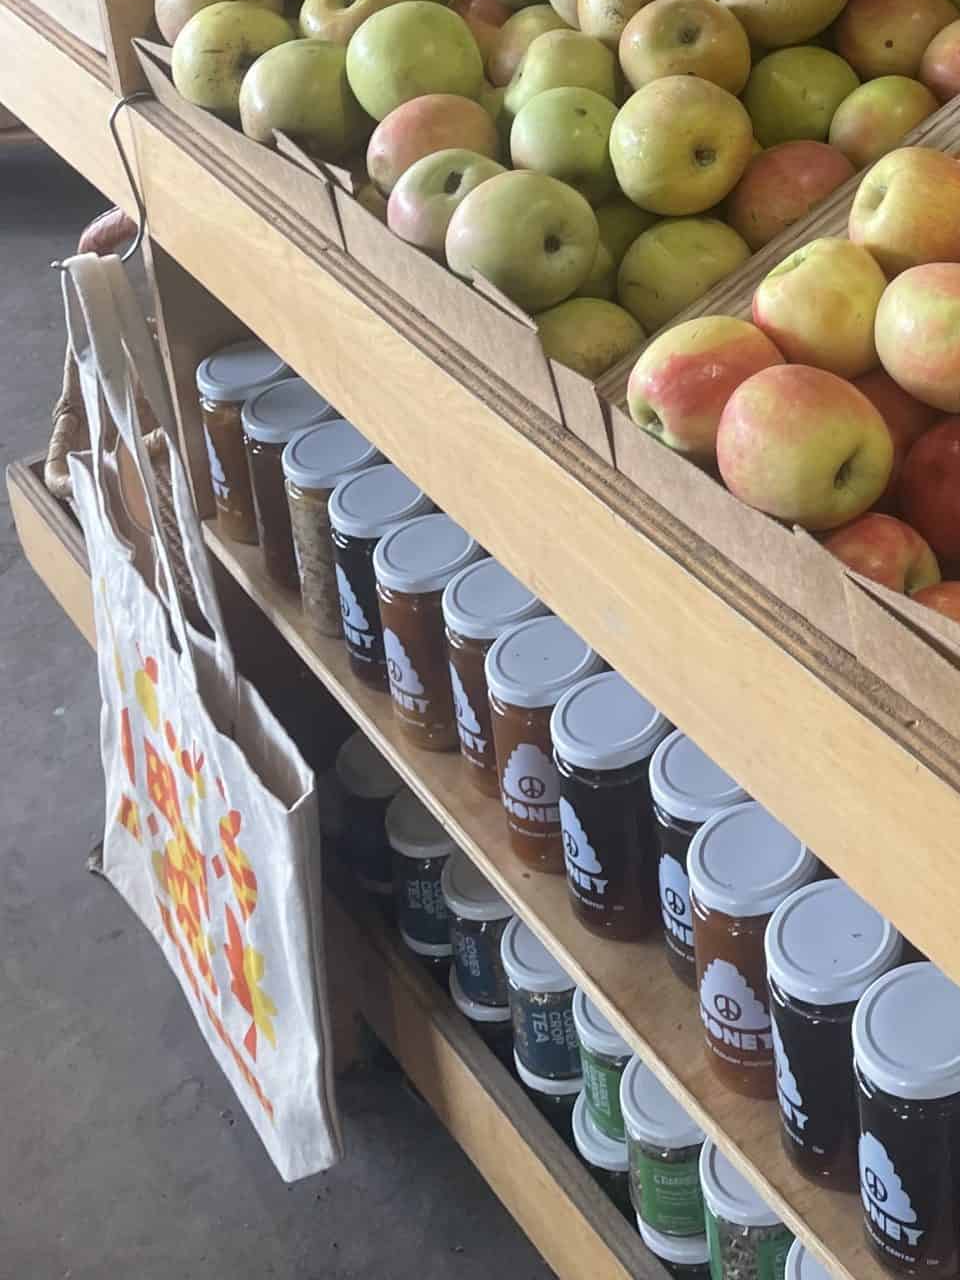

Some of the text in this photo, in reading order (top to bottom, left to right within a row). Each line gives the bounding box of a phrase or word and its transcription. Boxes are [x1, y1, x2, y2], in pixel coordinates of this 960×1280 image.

[501, 792, 560, 823] HONE
[531, 1011, 550, 1043] TEA
[549, 1011, 565, 1046] CROP
